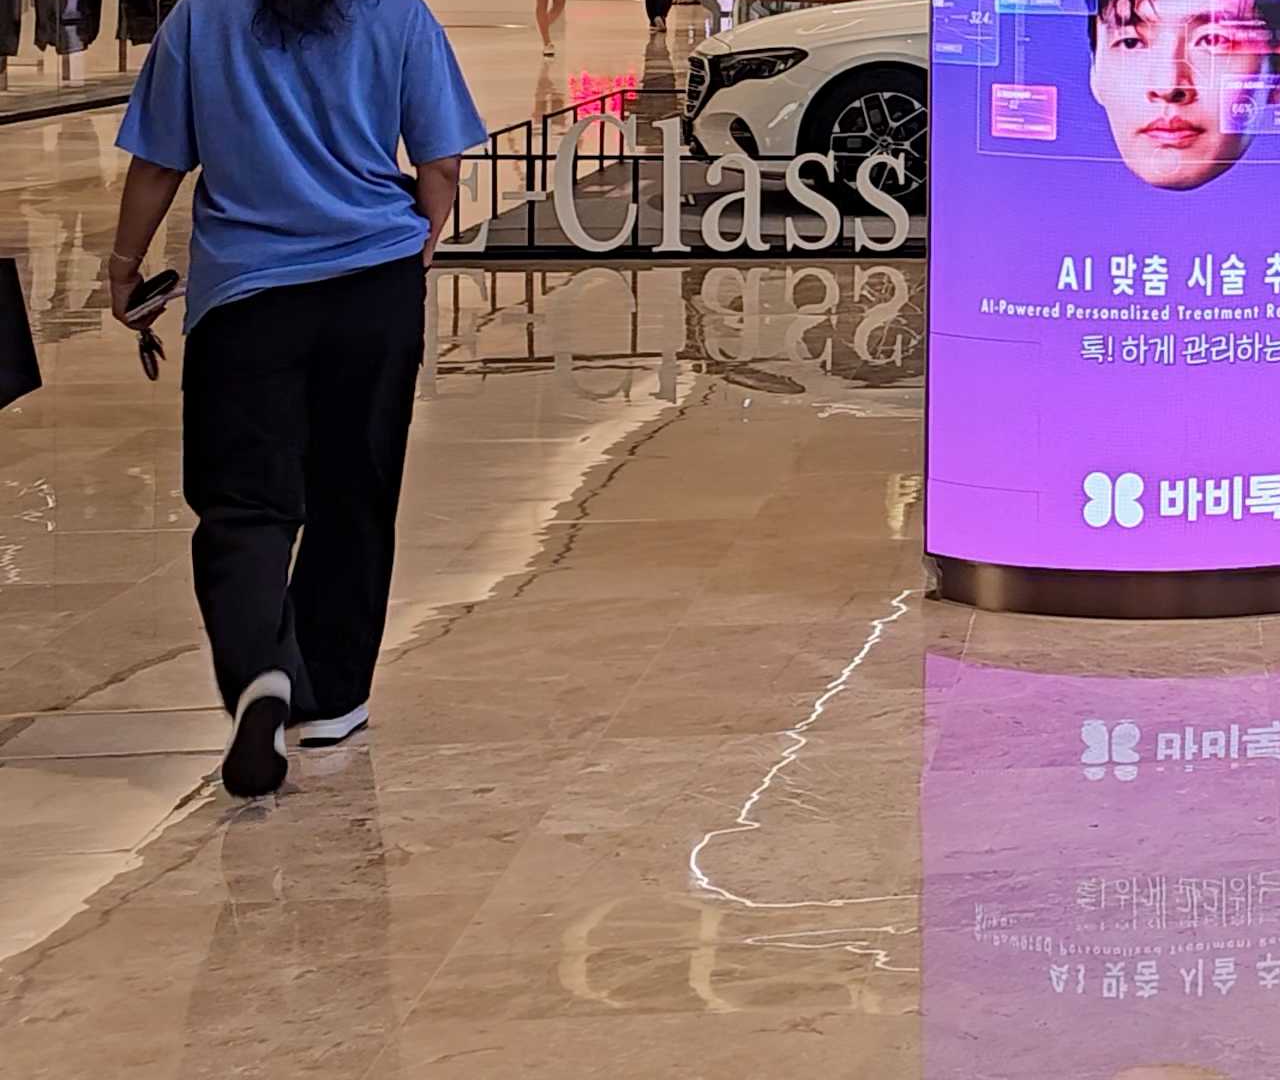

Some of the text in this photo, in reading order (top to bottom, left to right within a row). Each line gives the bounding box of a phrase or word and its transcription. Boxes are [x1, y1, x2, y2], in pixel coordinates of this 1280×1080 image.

[1057, 256, 1093, 291] AI
[1110, 253, 1169, 296] 맞춤
[1187, 253, 1246, 296] 시술
[981, 298, 1060, 319] AI-Powered
[1066, 303, 1170, 321] Personalized
[1177, 304, 1260, 321] Treatment
[1080, 333, 1114, 364] 톡!
[1121, 332, 1176, 365] 하게
